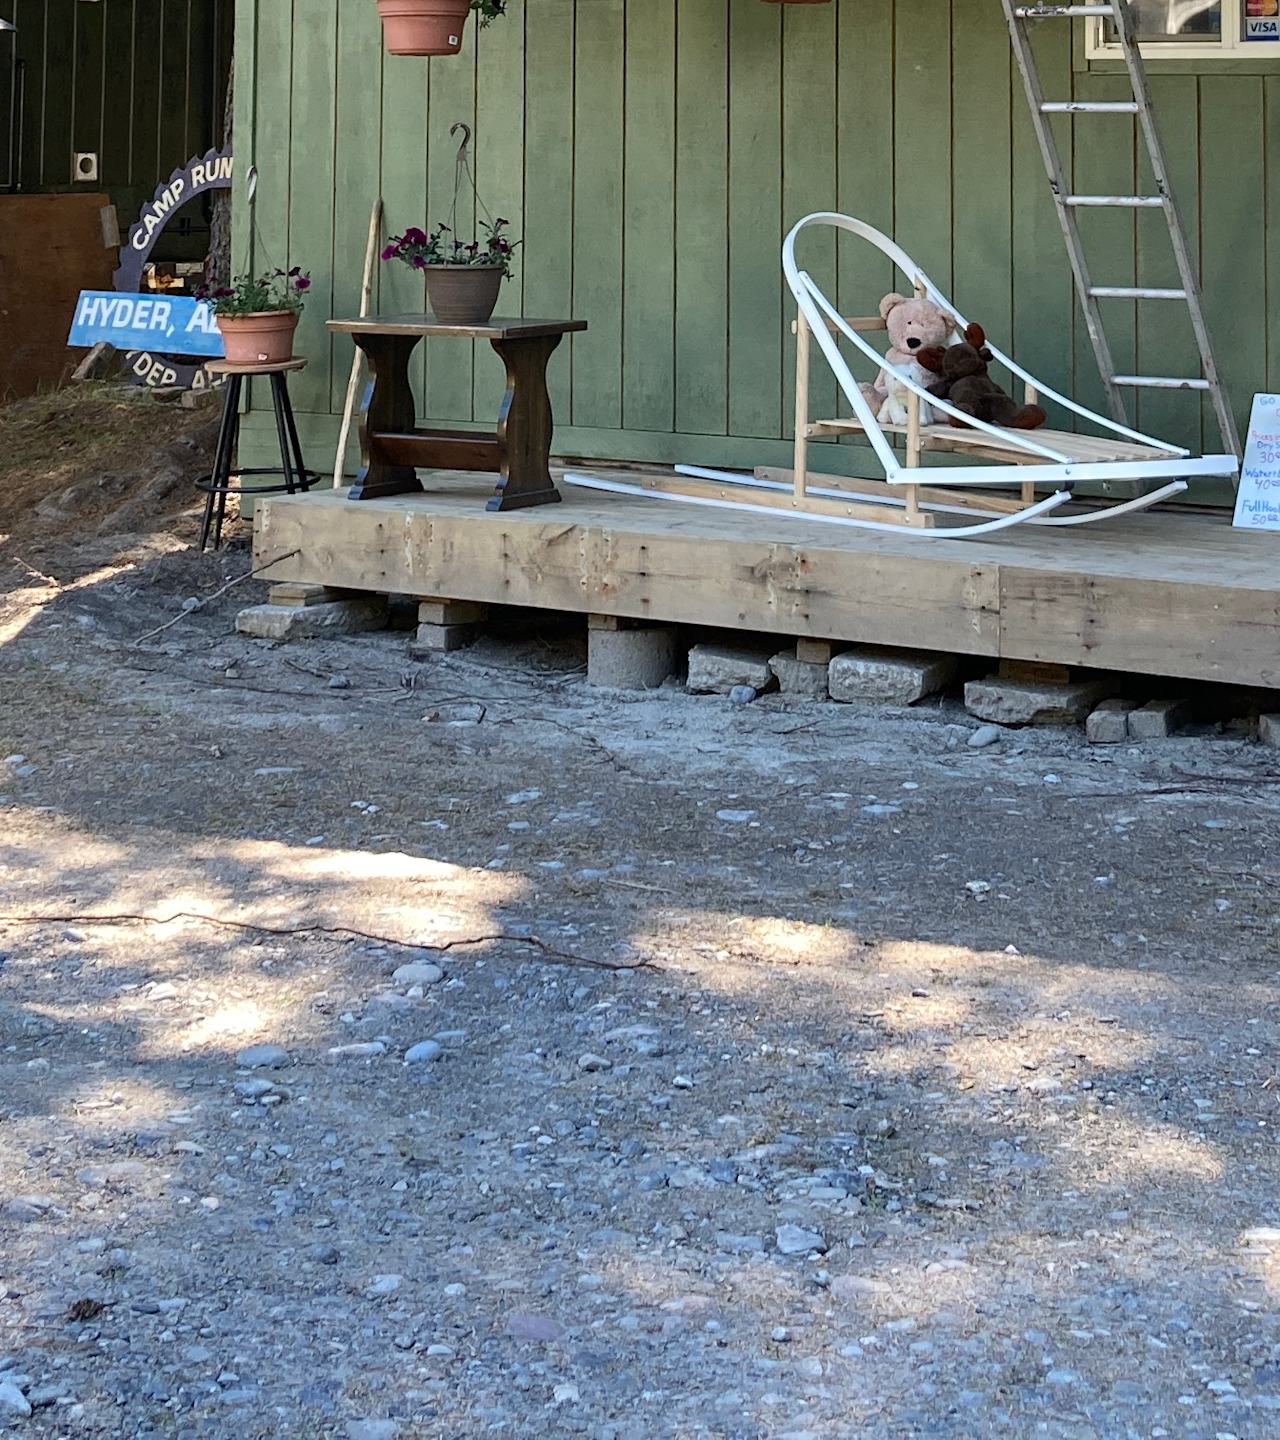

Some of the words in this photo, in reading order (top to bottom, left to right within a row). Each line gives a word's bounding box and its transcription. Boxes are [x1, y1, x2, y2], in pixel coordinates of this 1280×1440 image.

[1250, 22, 1277, 32] VISA
[132, 178, 185, 250] CAMP
[78, 296, 175, 338] HYDER,
